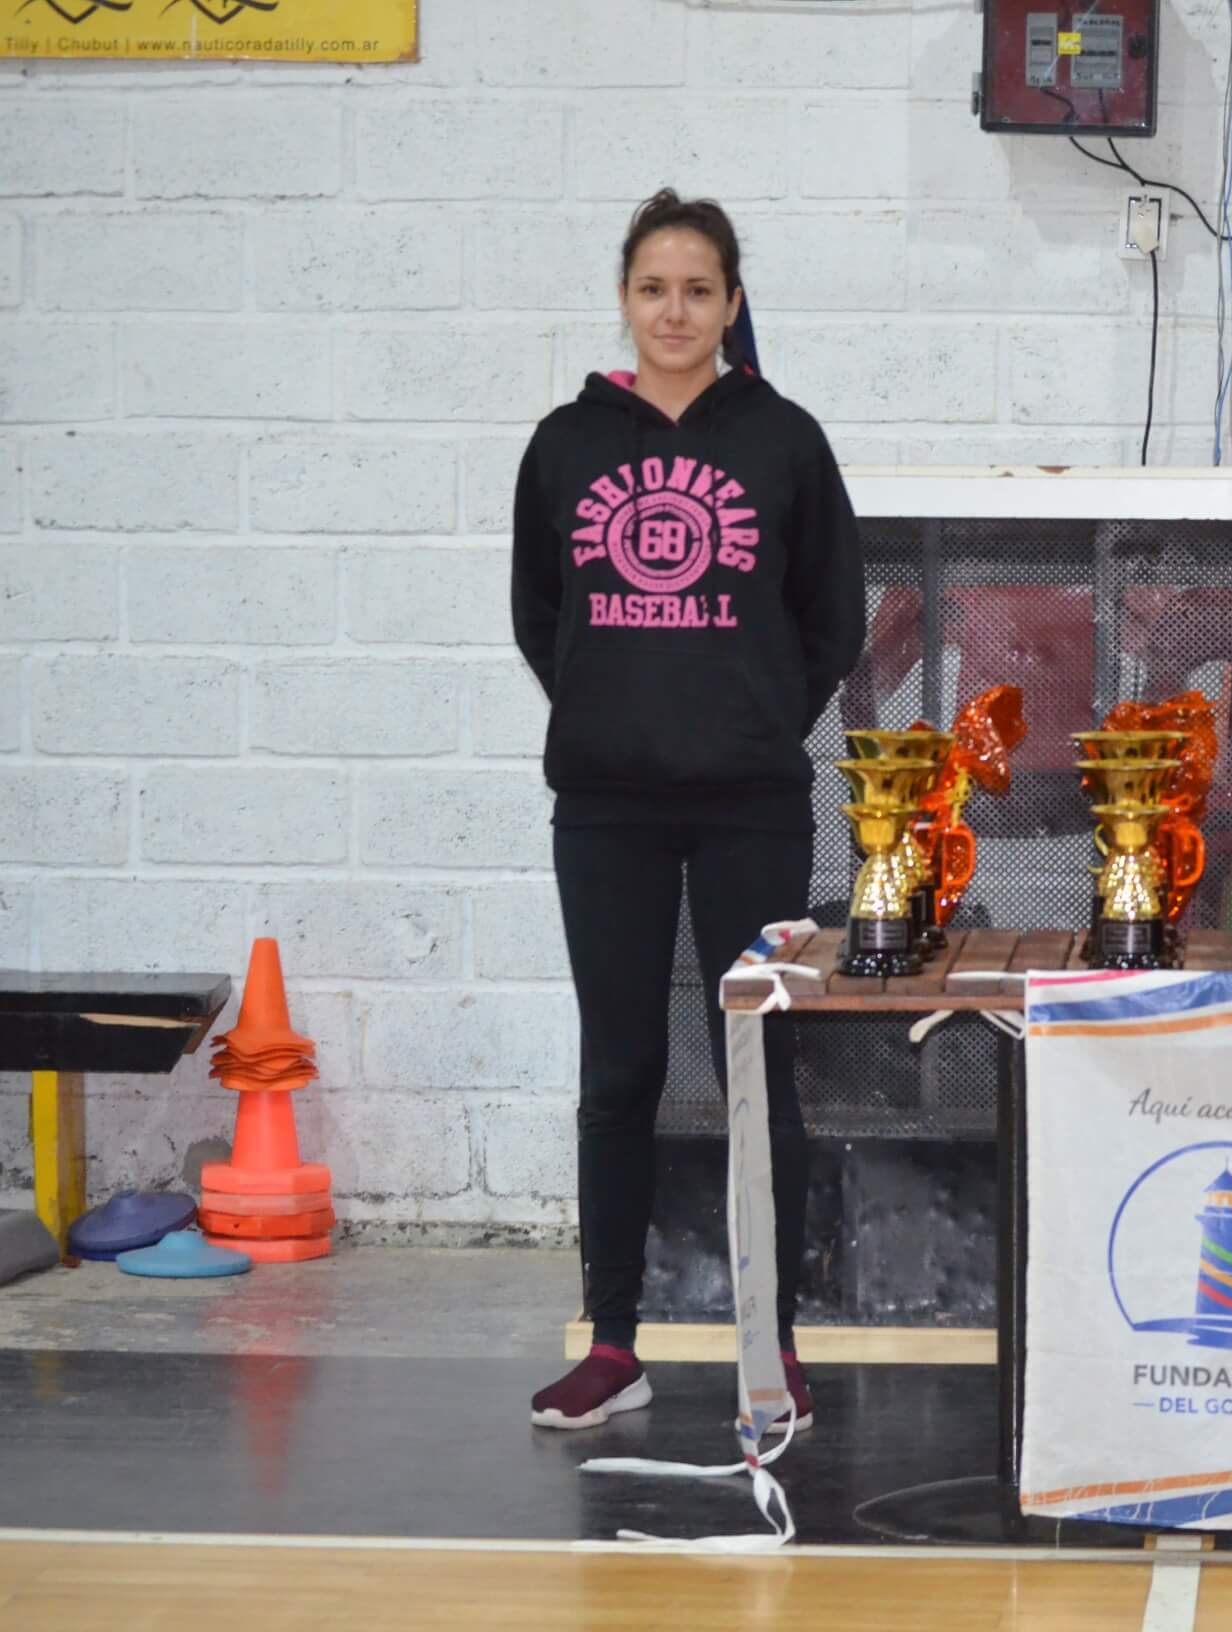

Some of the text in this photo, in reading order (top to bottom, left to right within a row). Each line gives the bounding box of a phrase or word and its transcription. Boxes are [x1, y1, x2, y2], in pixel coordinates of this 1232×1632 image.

[4, 36, 38, 54] Tilly
[57, 36, 118, 51] Chubut
[638, 519, 686, 561] 68
[588, 592, 738, 628] BASEBAL
[1128, 1087, 1193, 1125] Aquí
[1159, 1396, 1199, 1414] DEL
